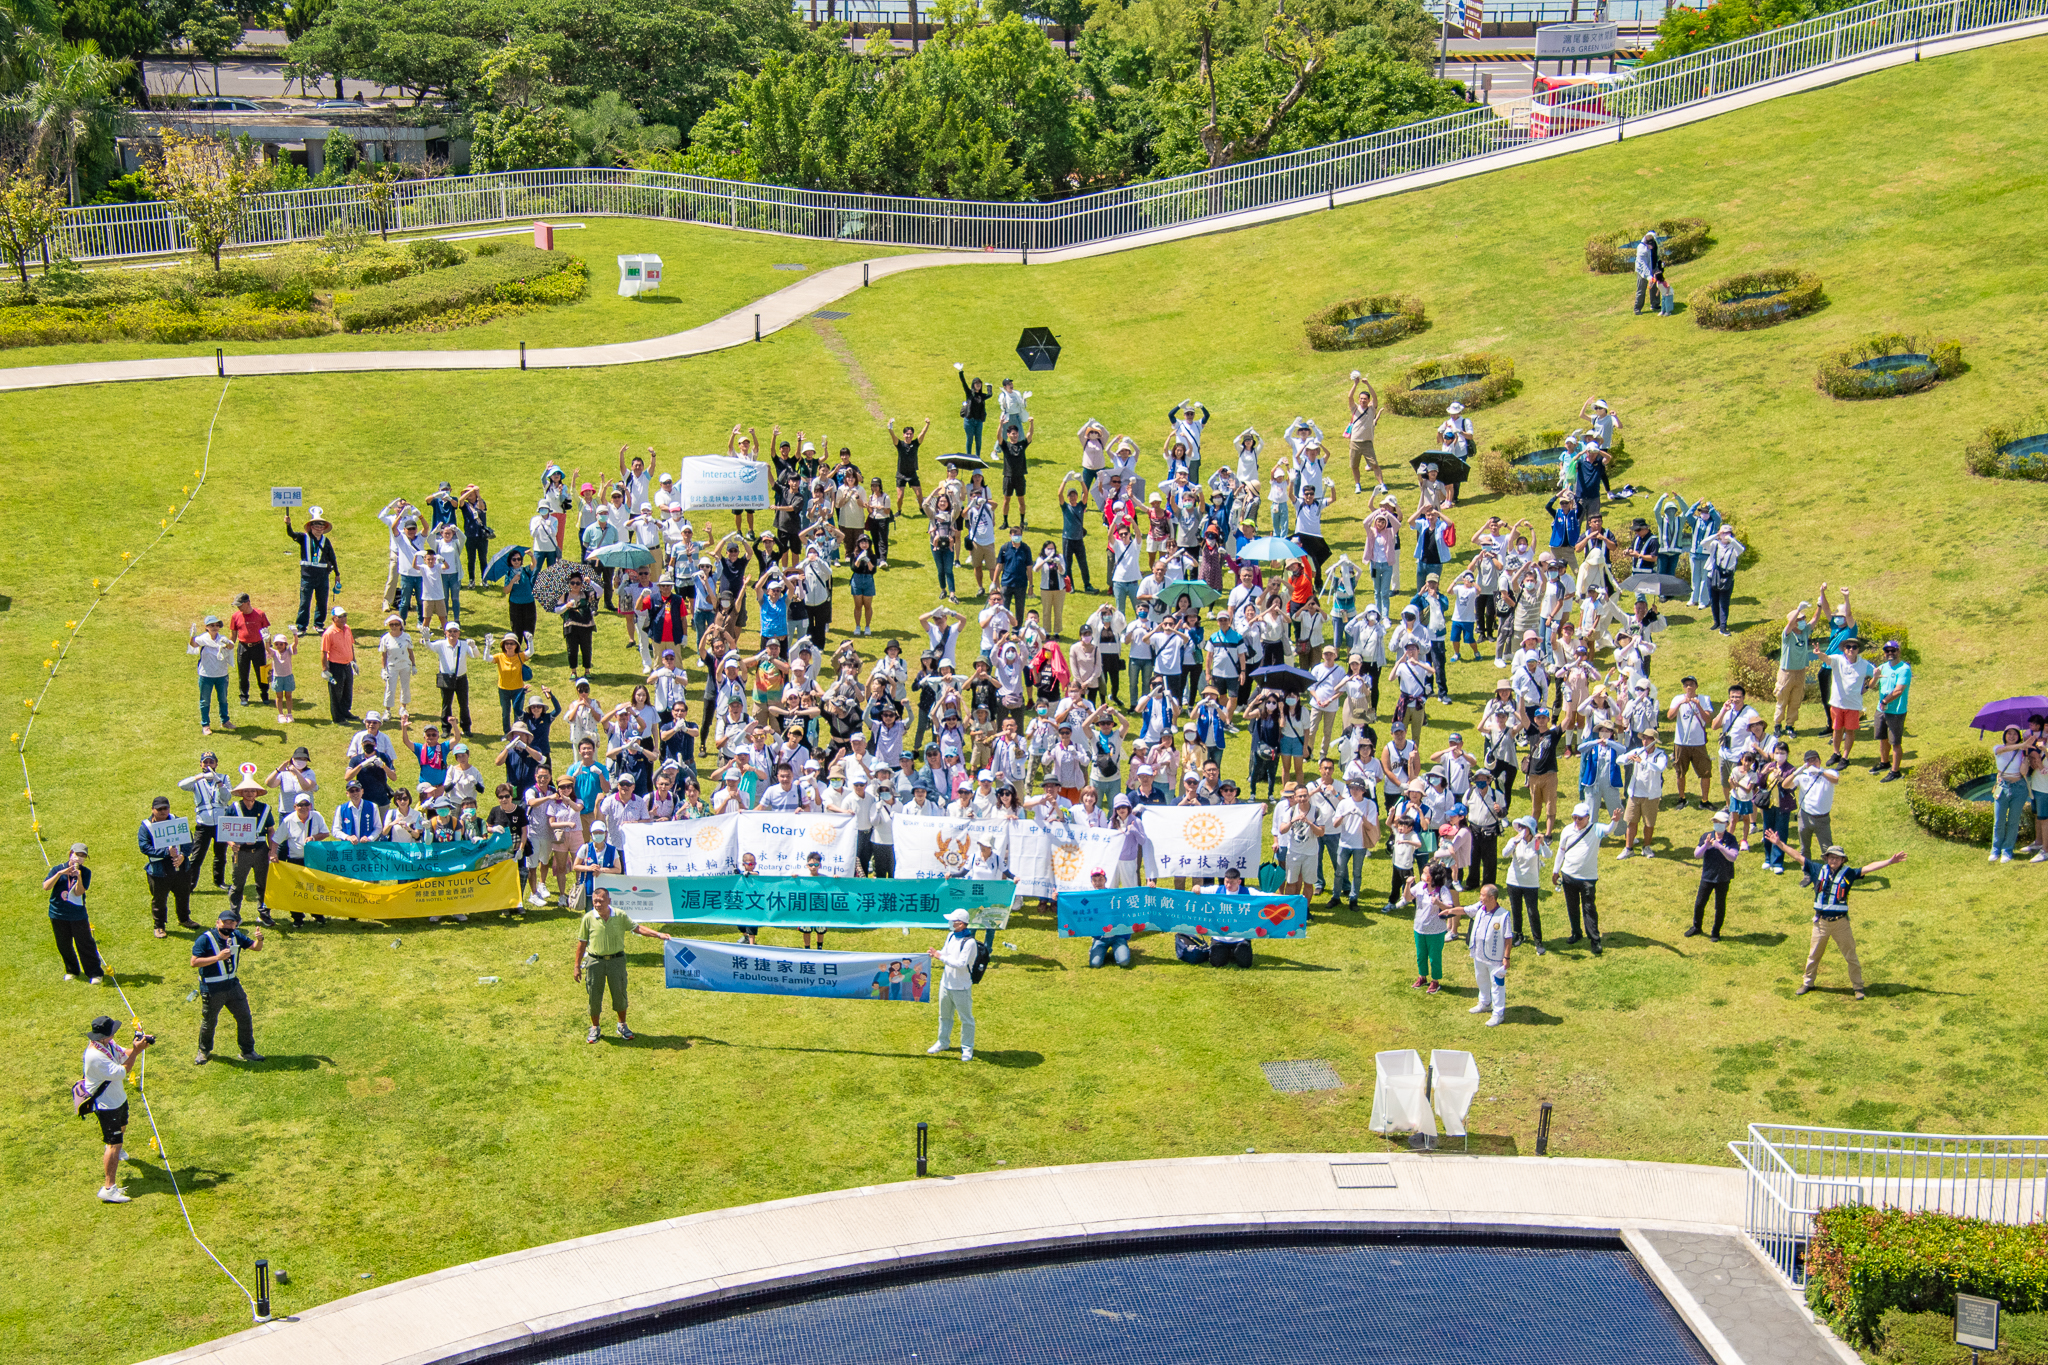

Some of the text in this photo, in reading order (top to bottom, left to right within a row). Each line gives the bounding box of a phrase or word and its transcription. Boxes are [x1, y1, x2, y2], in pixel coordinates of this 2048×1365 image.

[1579, 44, 1600, 53] GREEN
[702, 470, 737, 479] Interact
[273, 491, 302, 500] 海口組
[154, 822, 189, 838] 山口組
[222, 822, 252, 832] 河口組
[762, 823, 806, 838] Rotary
[646, 835, 692, 848] Rotary
[326, 863, 440, 873] FAB GREEN VILLAGE
[646, 857, 735, 875] 永和扶輪社
[758, 864, 782, 872] Rotary
[1160, 854, 1247, 869] 中和扶輪社
[448, 878, 475, 887] TULIP
[293, 891, 381, 905] FAB GREEN VILLAGE
[681, 889, 940, 913] 滬尾藝文休閒園區 淨灘活動
[1165, 912, 1212, 922] VOLUNTEER
[732, 955, 838, 976] 將捷家庭日
[733, 971, 838, 987] Fabulous Family Day
